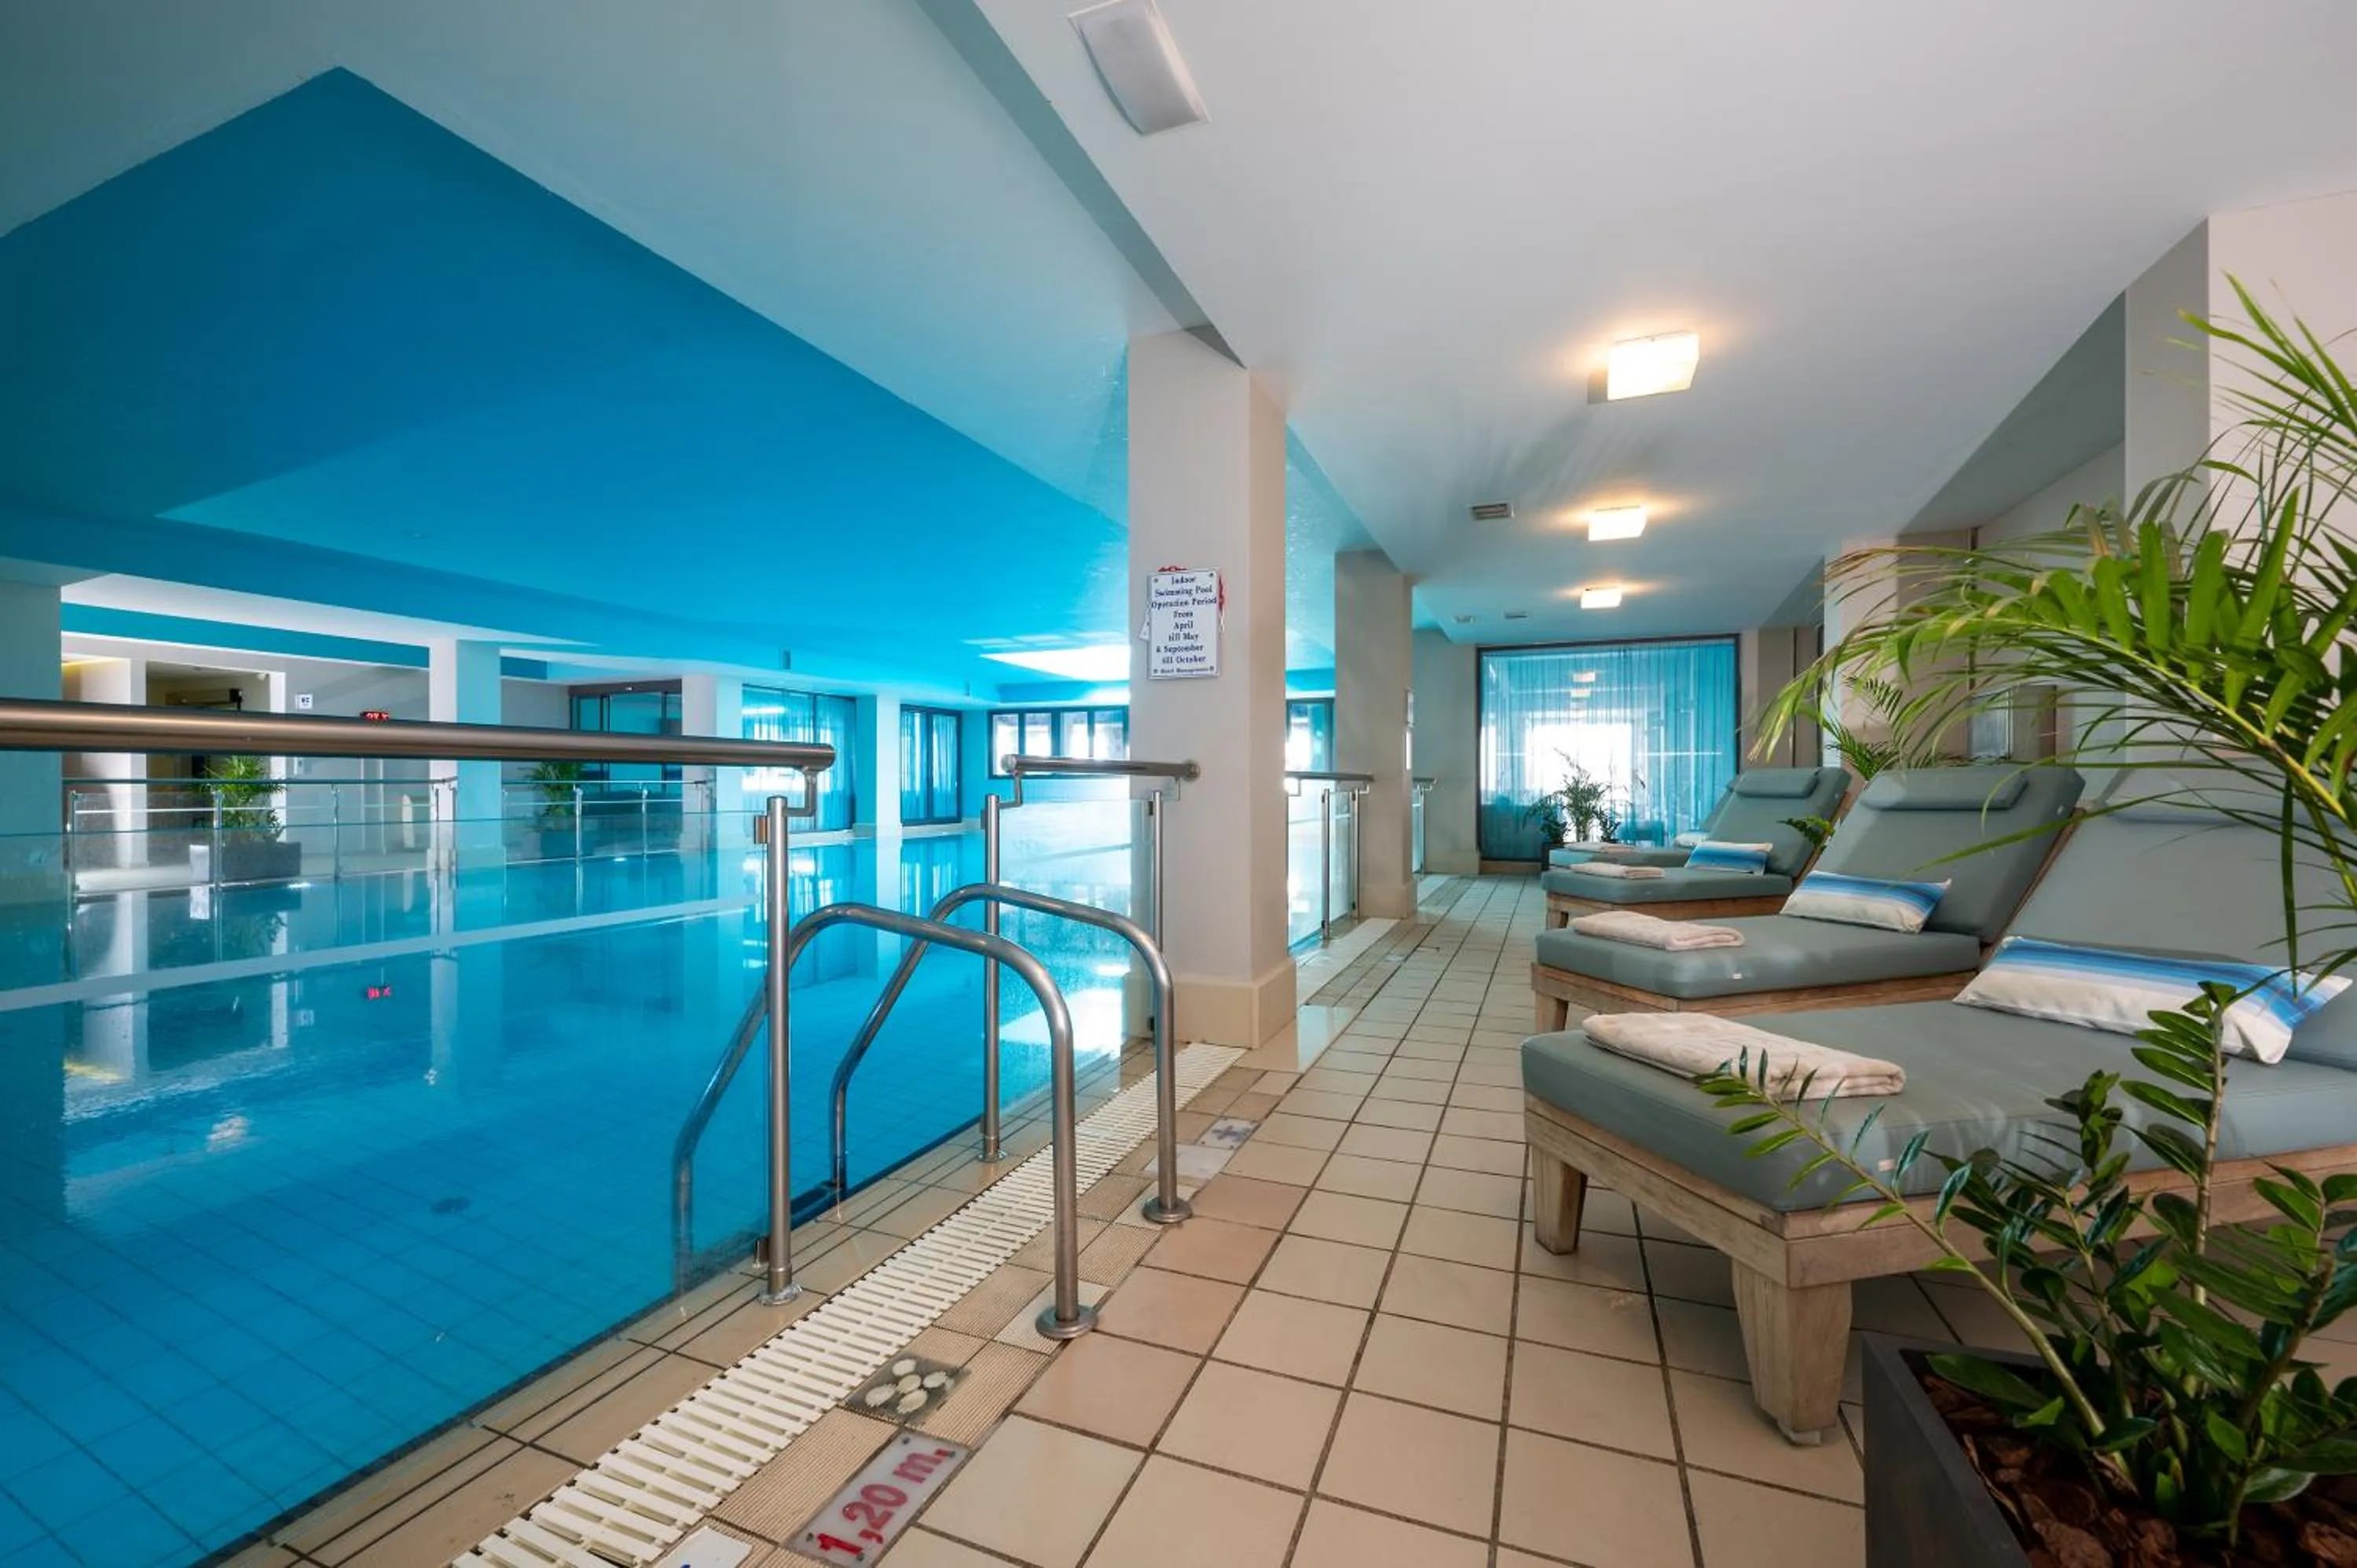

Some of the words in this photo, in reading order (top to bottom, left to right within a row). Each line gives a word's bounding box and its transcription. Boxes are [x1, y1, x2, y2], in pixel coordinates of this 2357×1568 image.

[1155, 588, 1193, 597] Swimming
[1196, 584, 1212, 594] Pool
[1192, 597, 1217, 606] Period
[1174, 620, 1193, 632] April
[1183, 632, 1198, 641] May
[1164, 644, 1204, 654] September
[1175, 655, 1206, 664] October
[816, 1483, 908, 1555] 1,20
